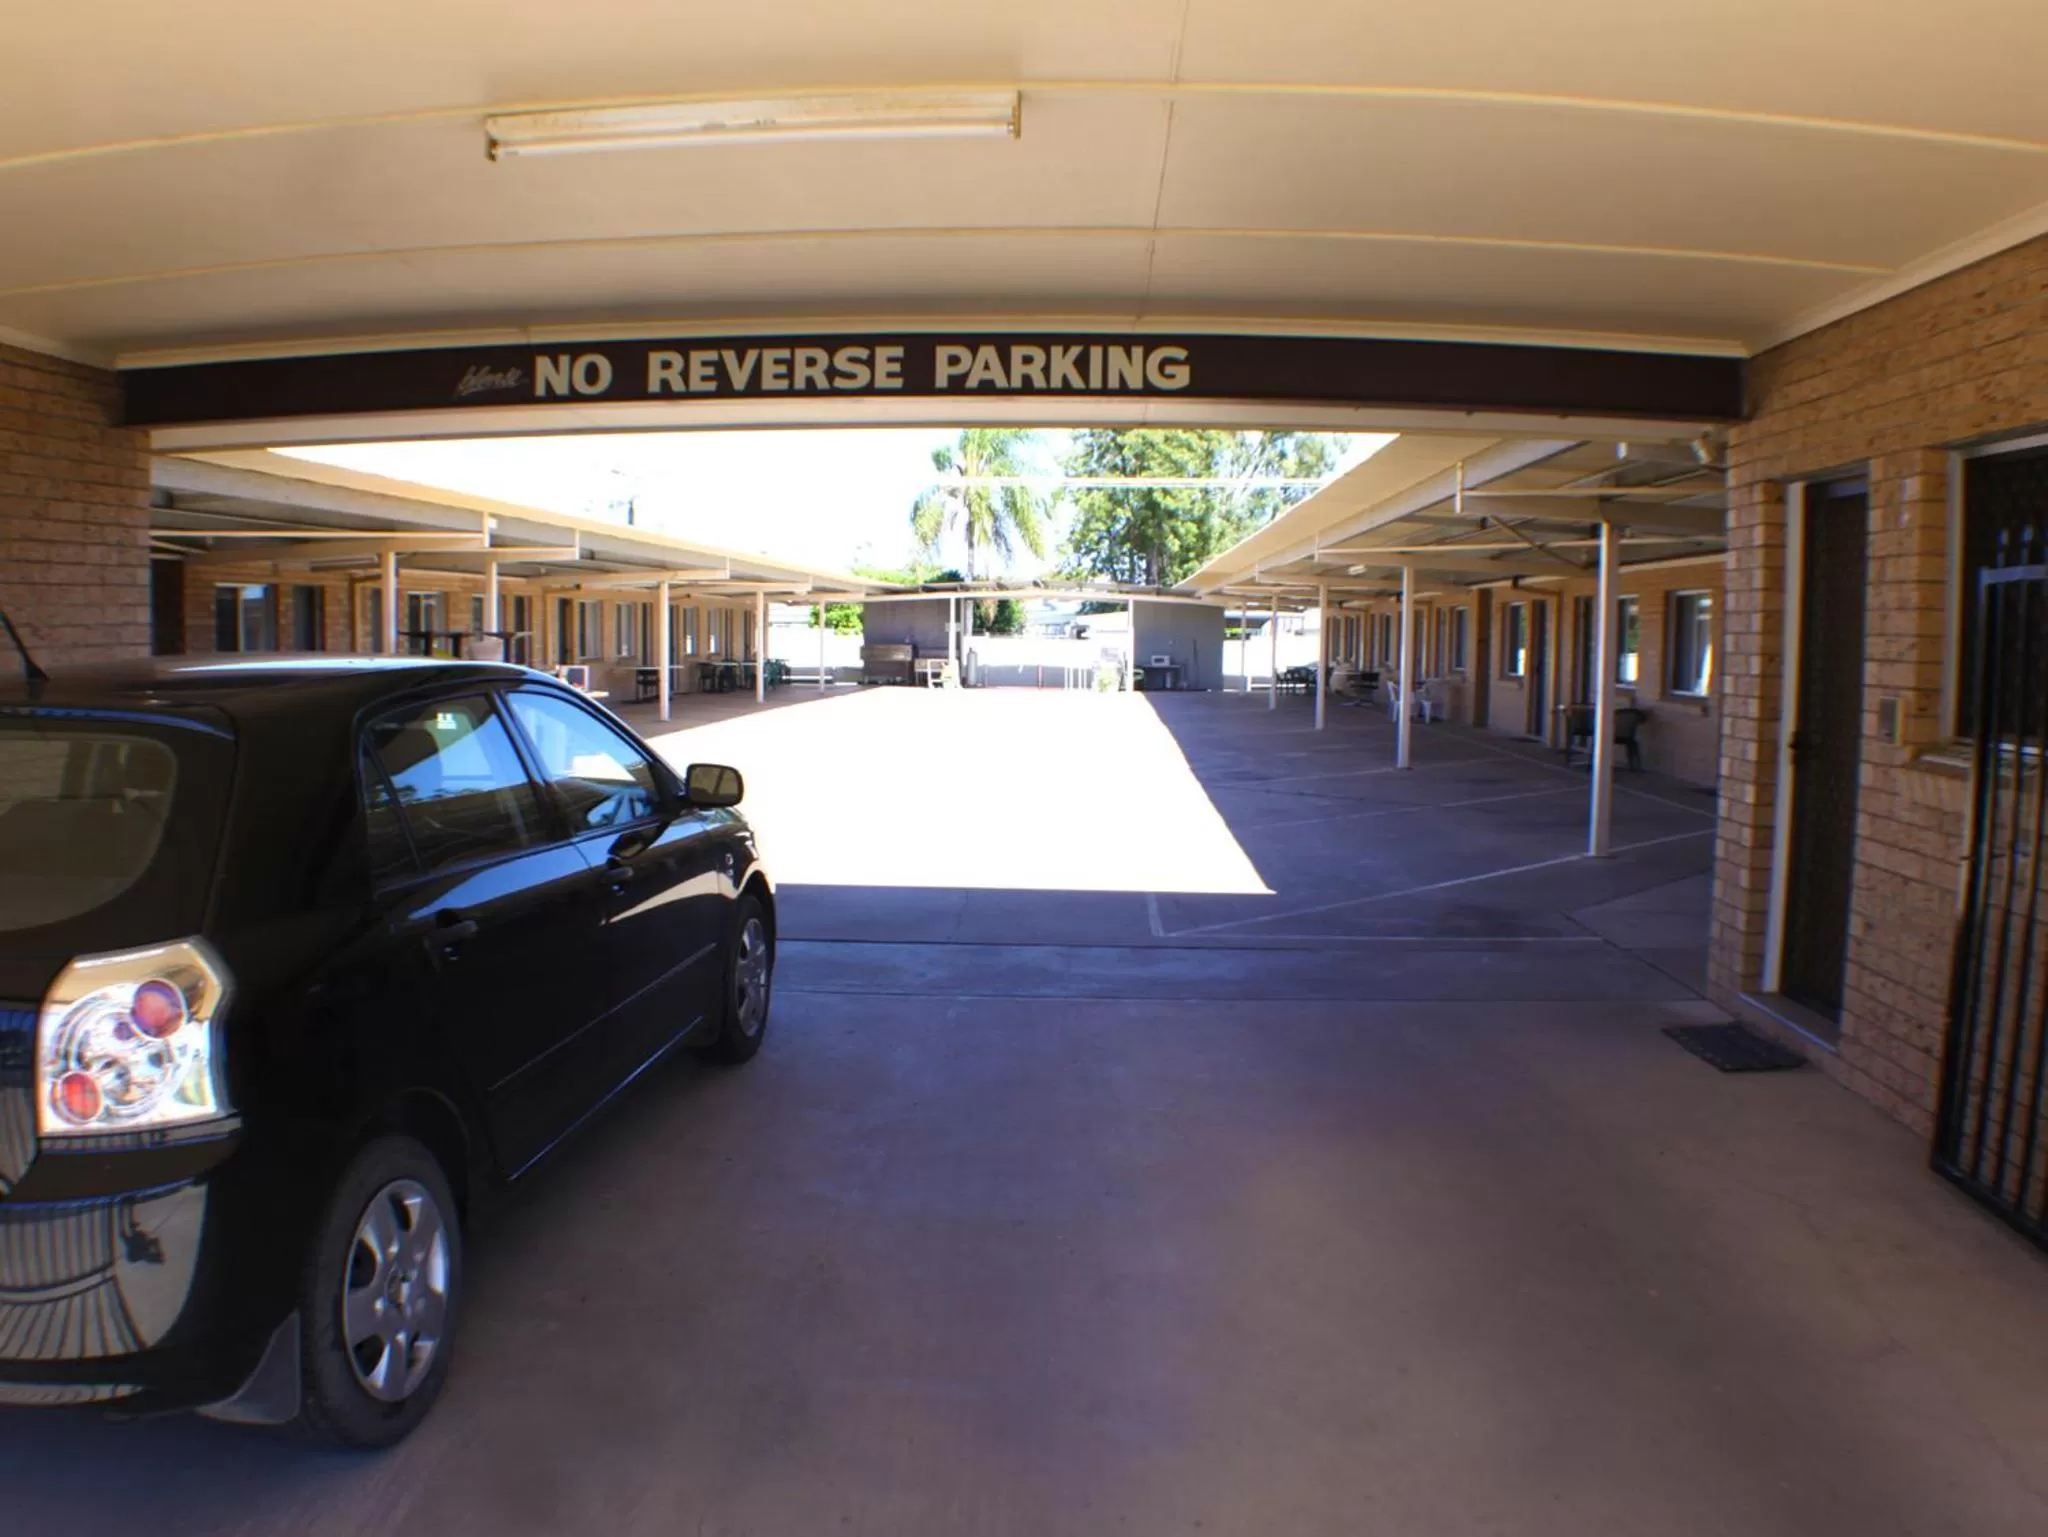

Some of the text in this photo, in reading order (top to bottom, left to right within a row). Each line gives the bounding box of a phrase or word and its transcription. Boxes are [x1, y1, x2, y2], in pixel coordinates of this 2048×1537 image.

[534, 353, 612, 396] NO
[647, 345, 905, 393] REVERSE
[934, 344, 1191, 391] PARKING
